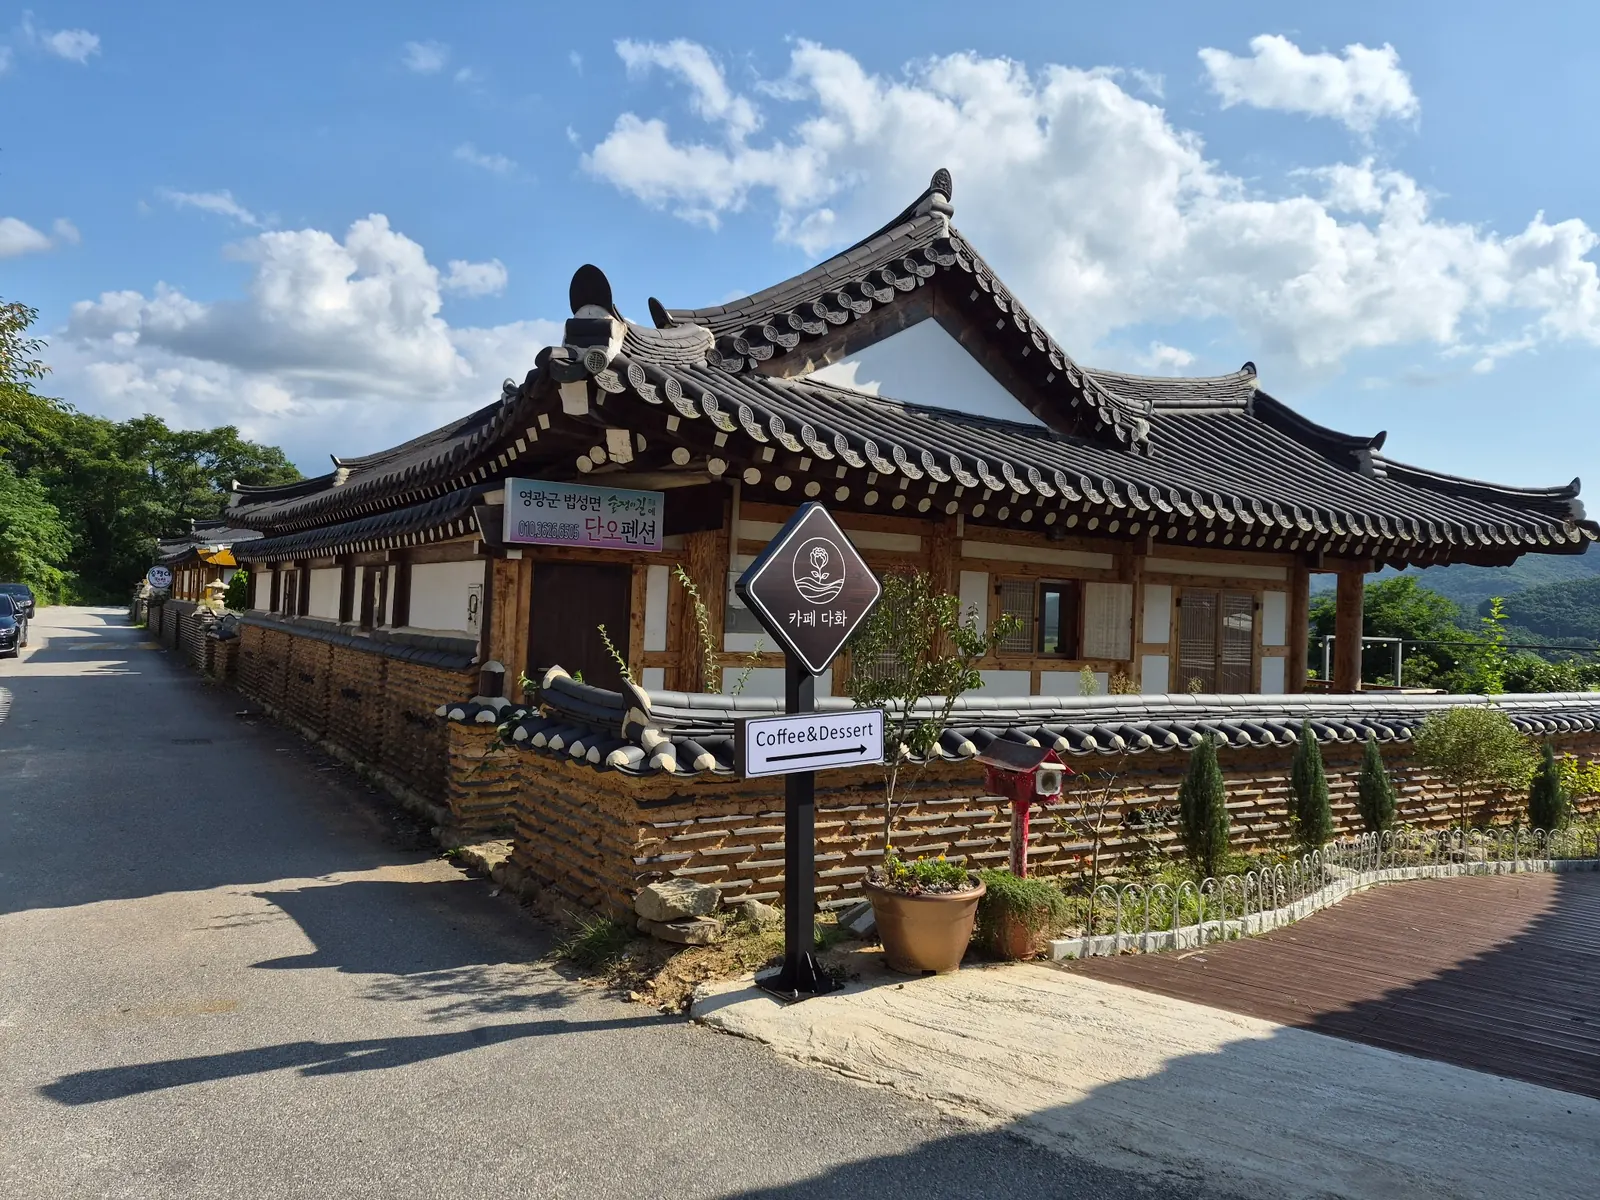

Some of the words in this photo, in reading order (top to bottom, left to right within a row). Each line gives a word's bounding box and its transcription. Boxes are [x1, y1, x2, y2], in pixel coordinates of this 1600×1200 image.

[519, 489, 561, 509] 영광군
[564, 493, 601, 512] 법성면
[788, 609, 816, 628] 카페
[821, 609, 848, 628] 다화
[756, 722, 873, 747] Coffee&Dessert
